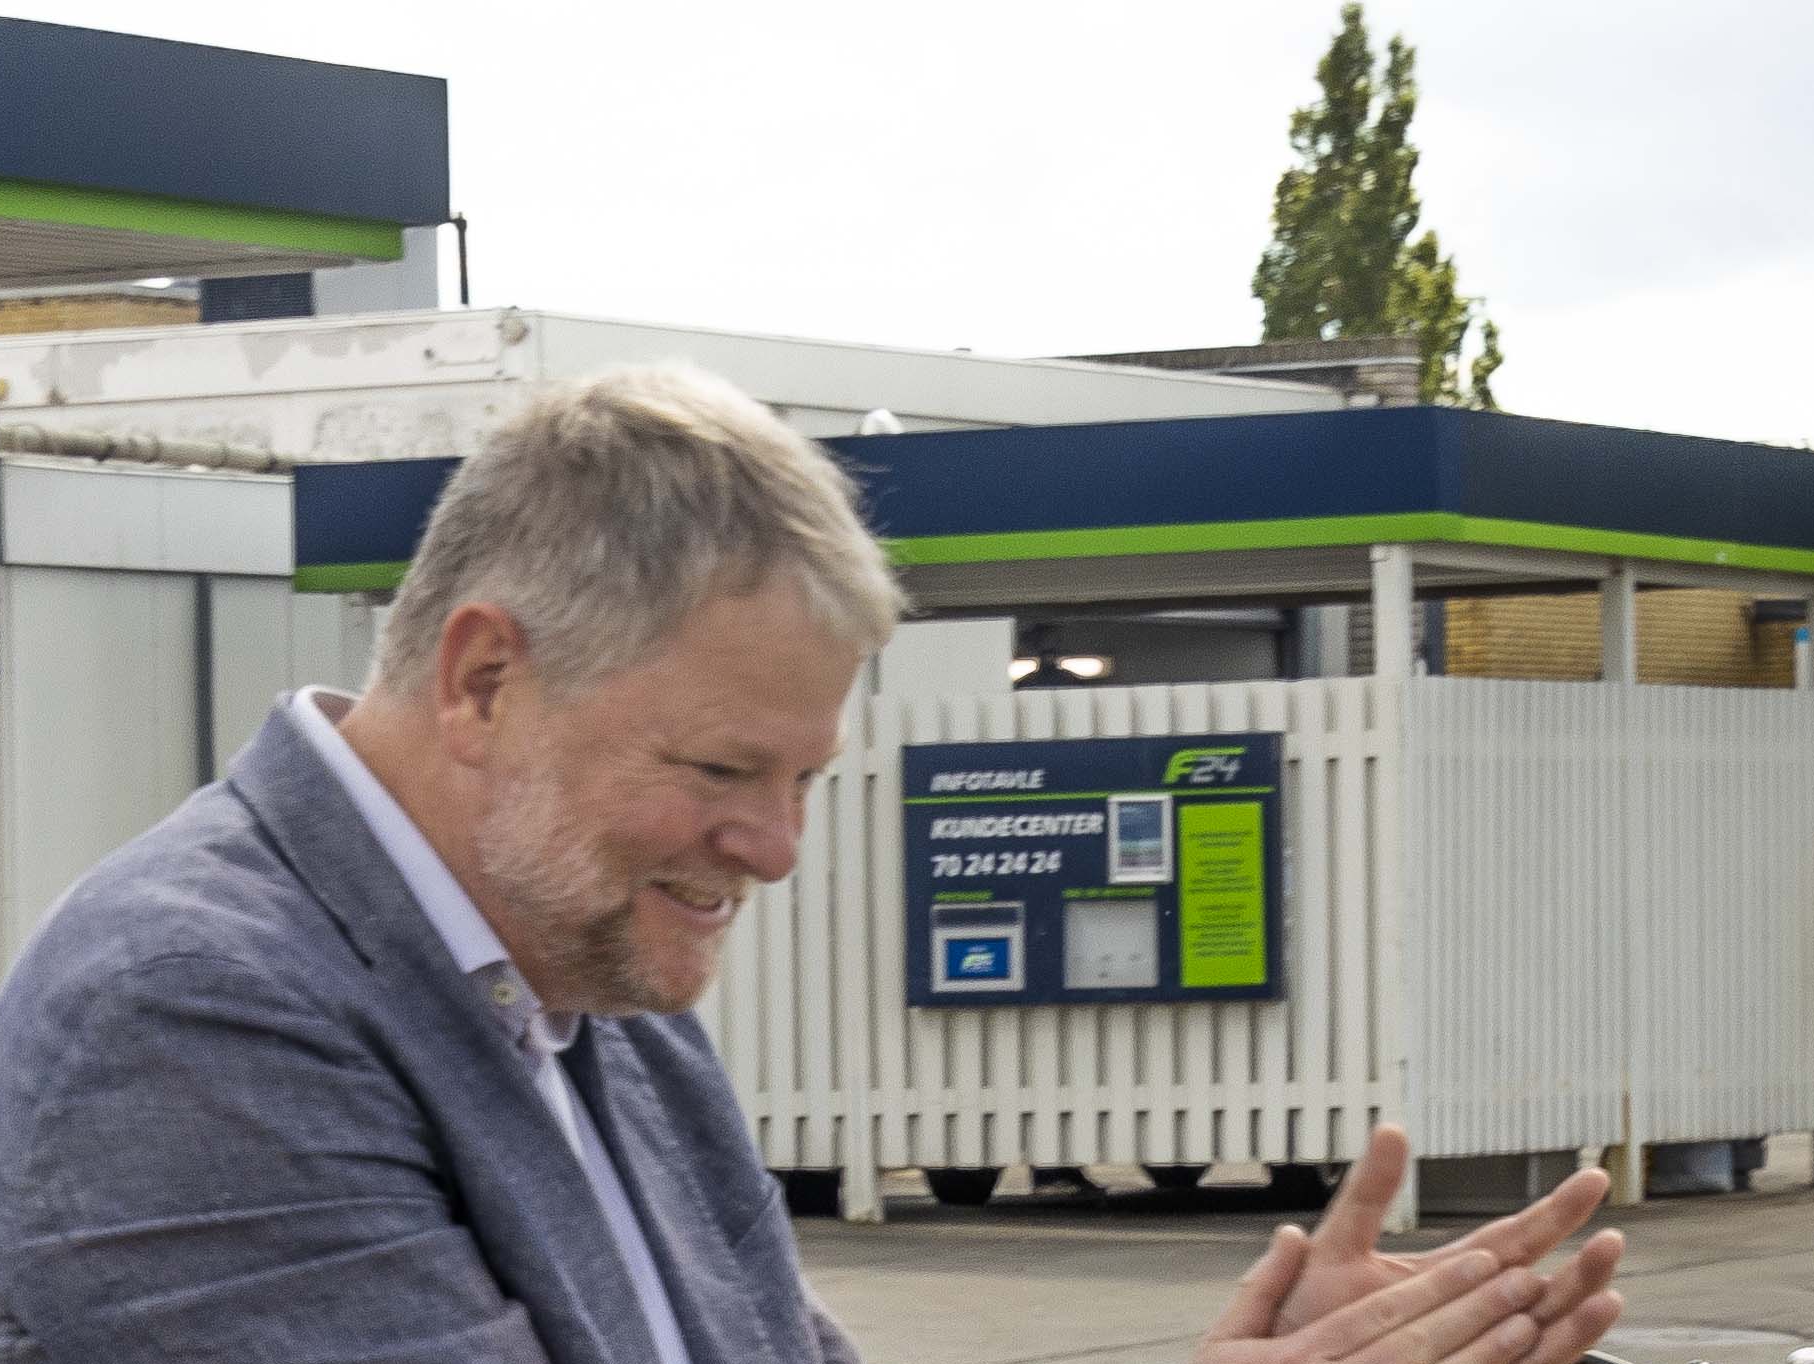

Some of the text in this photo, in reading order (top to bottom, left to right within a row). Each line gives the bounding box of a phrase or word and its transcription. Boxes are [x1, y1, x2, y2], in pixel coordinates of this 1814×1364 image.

[1163, 746, 1246, 784] F24
[930, 769, 1045, 793] INFOTAVLE
[930, 812, 1104, 840] KUNDECENTER
[931, 850, 1062, 878] 70 24 24 24
